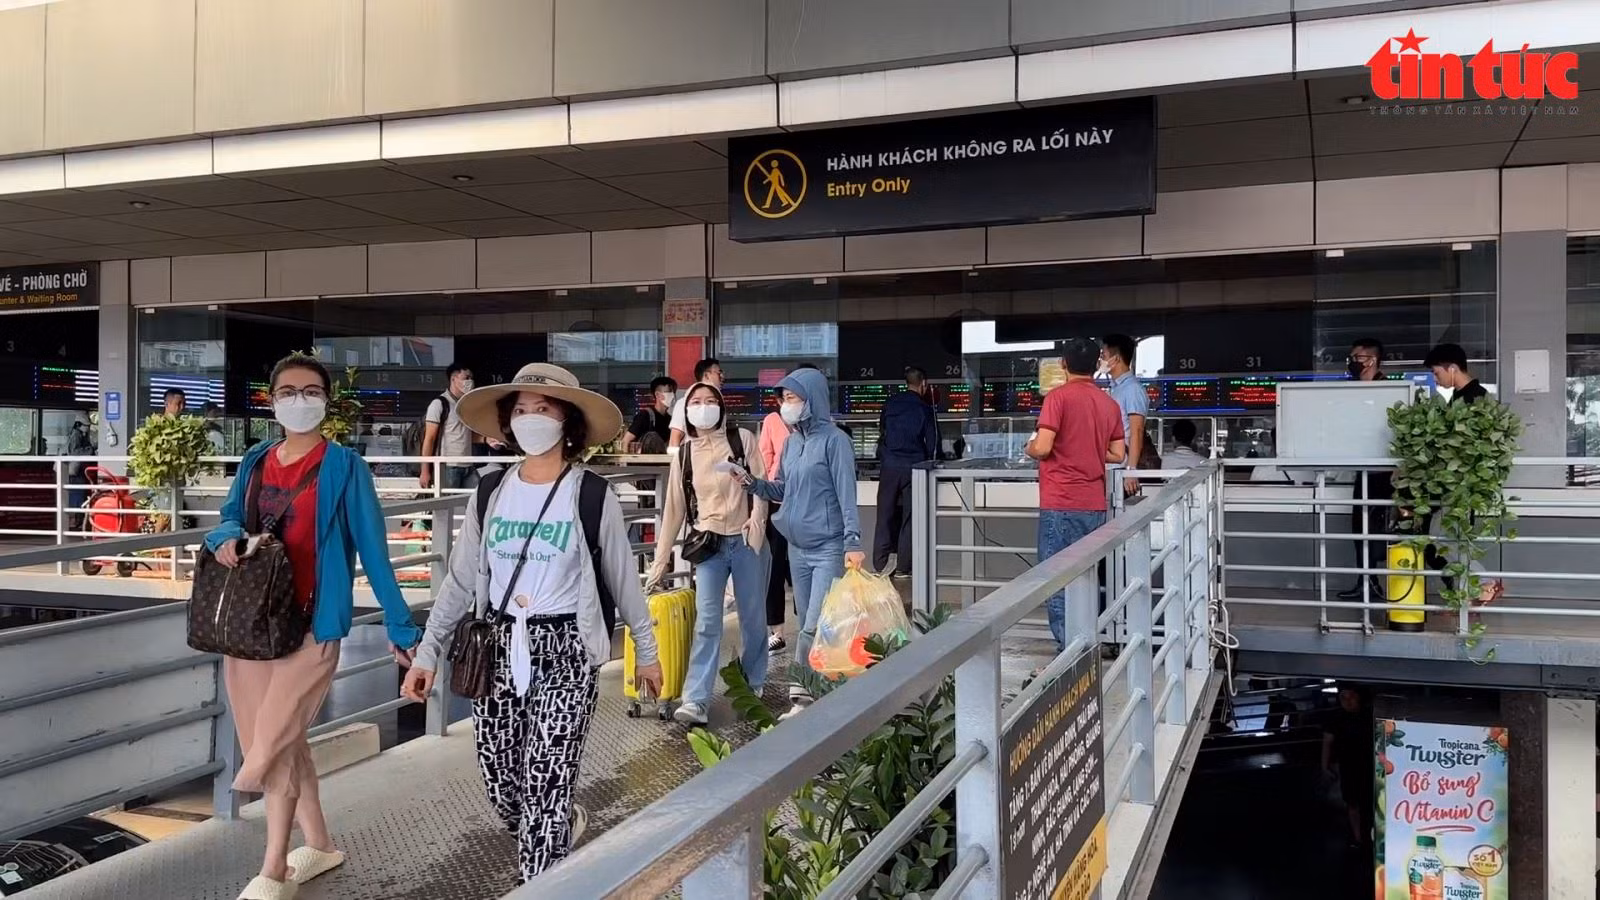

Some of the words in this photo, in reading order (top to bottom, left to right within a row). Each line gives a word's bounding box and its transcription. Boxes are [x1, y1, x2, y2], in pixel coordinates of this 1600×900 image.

[827, 152, 873, 172] HÀNH
[877, 146, 938, 168] KHÁCH
[943, 139, 1008, 161] KHÔNG
[1012, 138, 1036, 154] RA
[1041, 131, 1070, 150] LỐI
[1075, 127, 1114, 147] NÀY
[827, 182, 866, 198] Entry
[873, 177, 910, 196] Only
[22, 272, 60, 291] PHÒNG
[63, 269, 88, 288] CHỜ
[27, 294, 54, 305] Waiting
[56, 293, 78, 302] Room
[1179, 358, 1196, 369] 30
[1246, 357, 1261, 367] 31
[860, 367, 875, 377] 24
[945, 365, 960, 375] 26
[1438, 738, 1480, 750] Tropicana
[1405, 745, 1486, 768] Twister
[1403, 770, 1431, 795] Bổ
[1437, 772, 1481, 797] sung
[1394, 800, 1473, 824] Vitamin
[1477, 799, 1495, 822] C
[1488, 849, 1496, 862] 1
